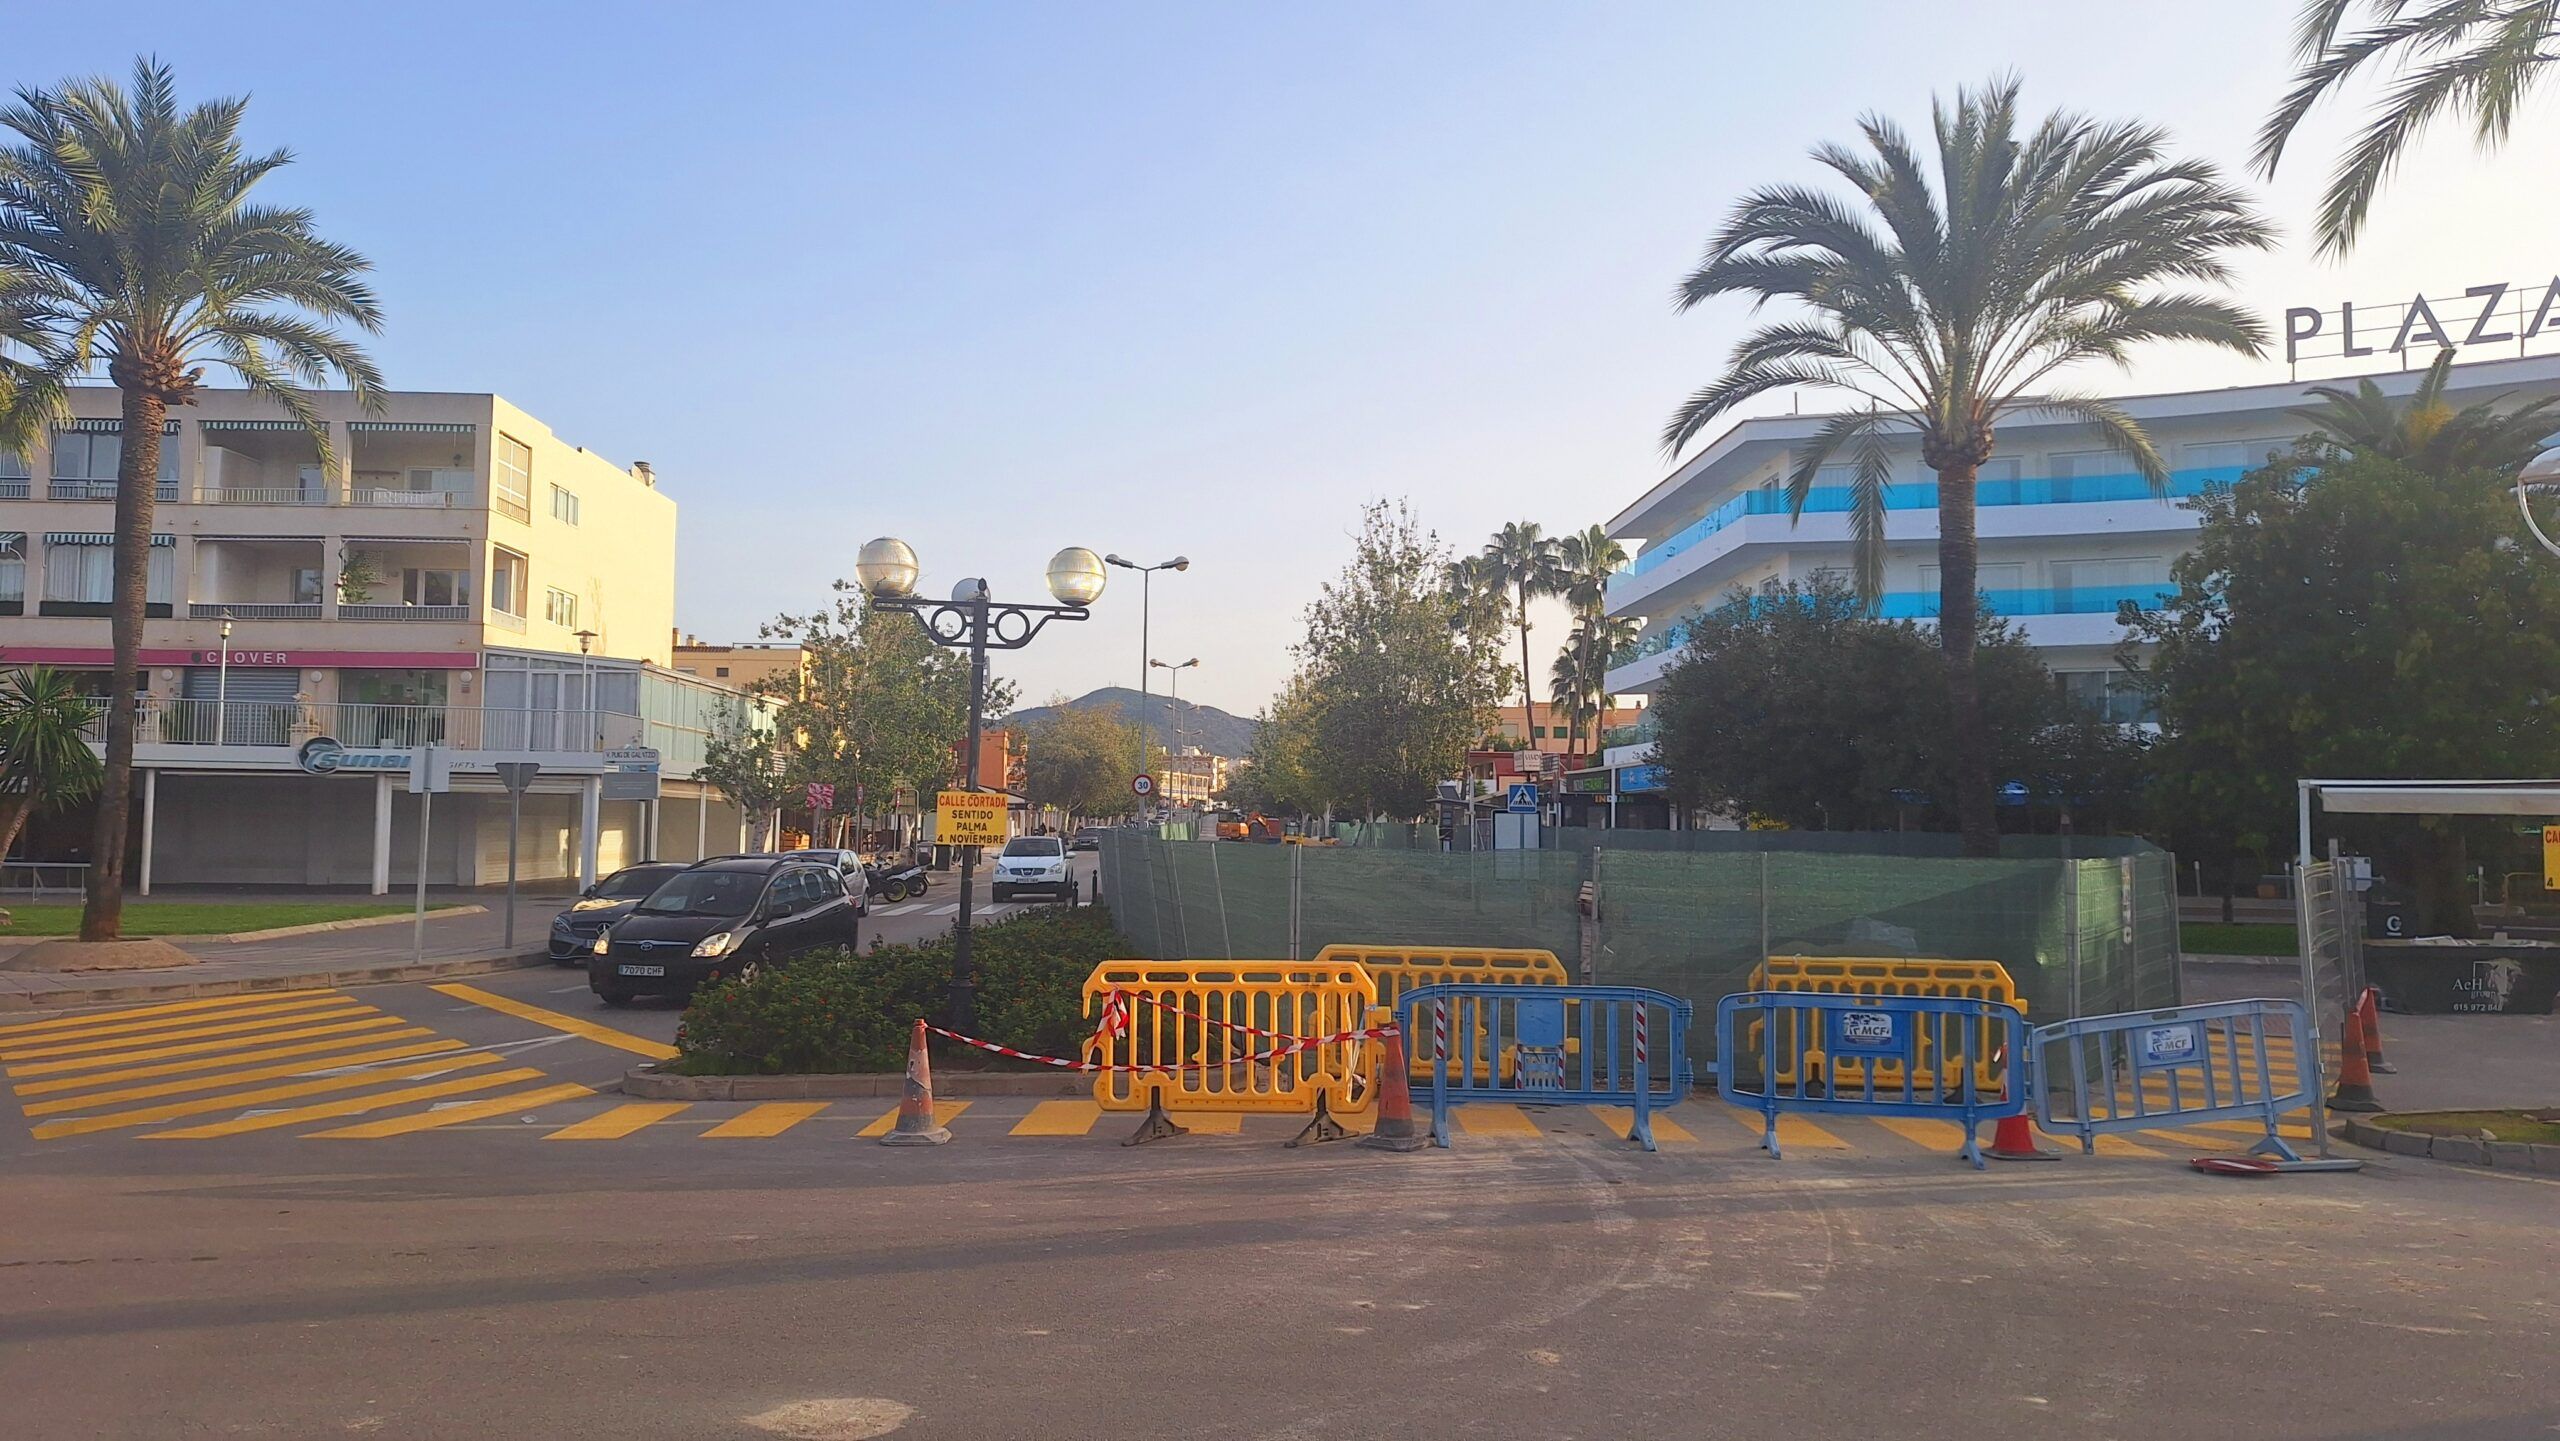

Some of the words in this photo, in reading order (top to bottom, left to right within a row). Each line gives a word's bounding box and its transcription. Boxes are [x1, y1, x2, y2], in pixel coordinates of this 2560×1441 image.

[2286, 274, 2560, 363] PLAZA
[1138, 781, 1148, 790] 30
[939, 795, 965, 806] CALLE
[967, 796, 1006, 807] CORTADA
[952, 810, 994, 820] SENTIDO
[956, 822, 987, 832] PALMA
[937, 834, 944, 843] 4
[949, 834, 1005, 844] NOVIEMBRE
[2546, 876, 2554, 888] 4
[624, 966, 646, 975] 7070
